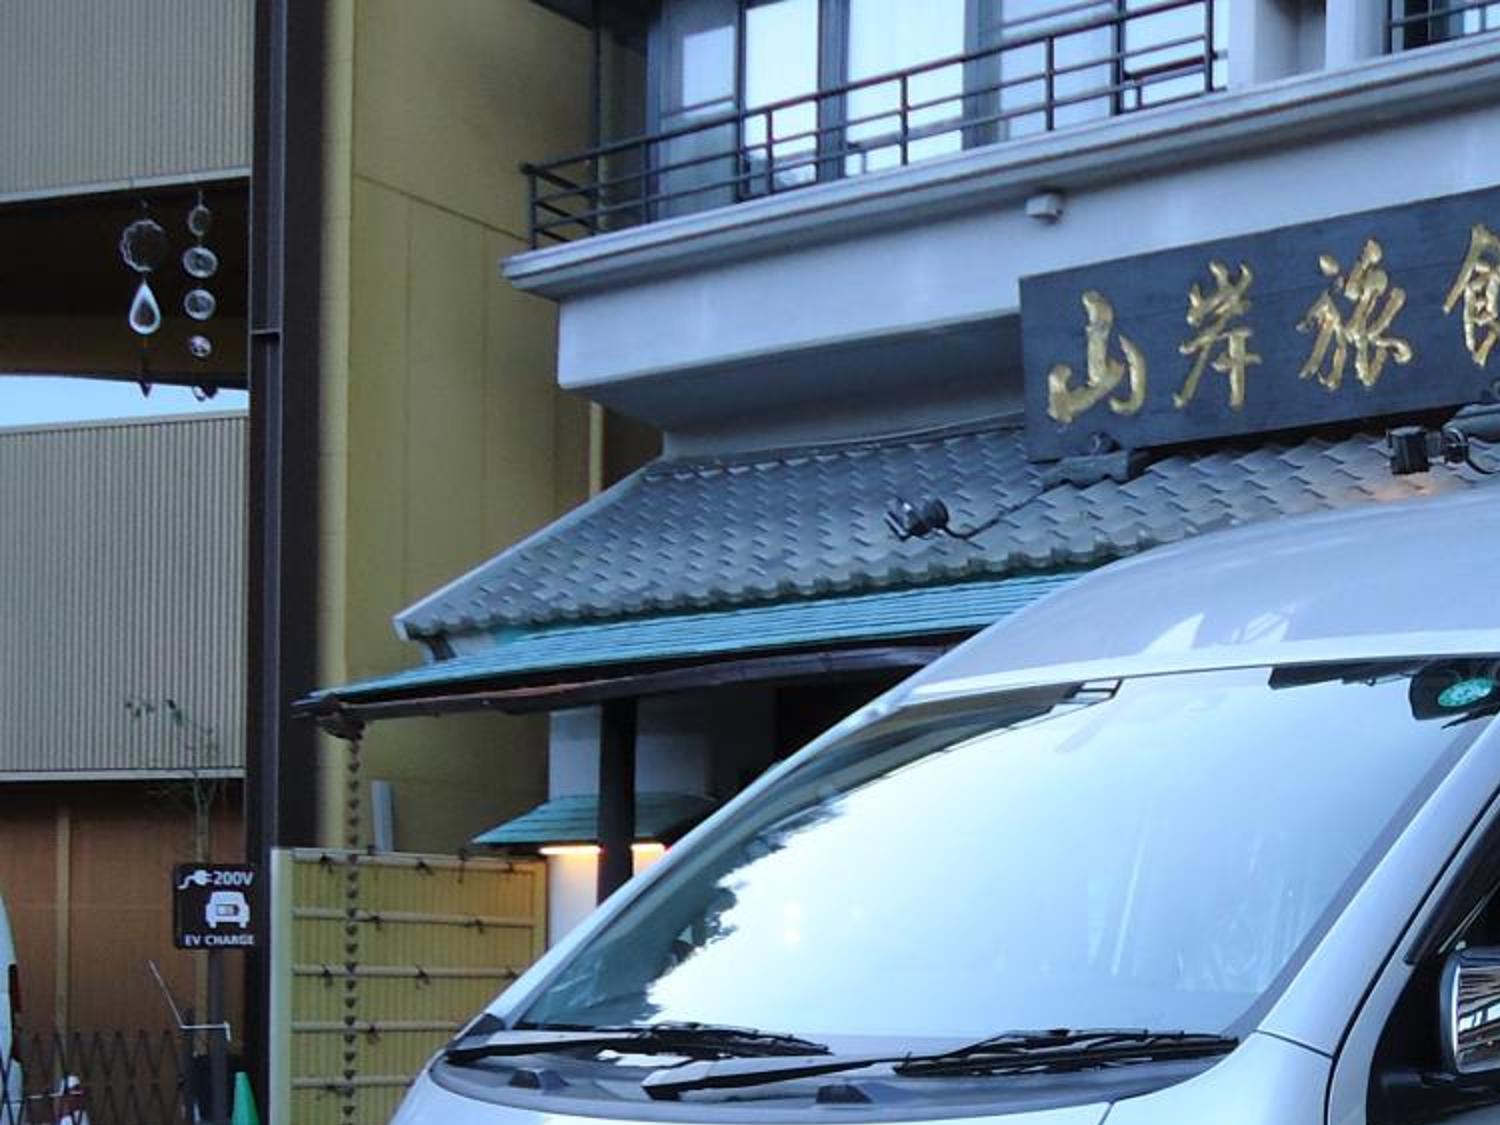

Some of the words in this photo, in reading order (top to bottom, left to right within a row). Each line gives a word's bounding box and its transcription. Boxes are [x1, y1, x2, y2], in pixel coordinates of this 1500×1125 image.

[212, 870, 254, 886] 200V
[184, 934, 201, 946] EV
[204, 933, 255, 946] CHARGE
